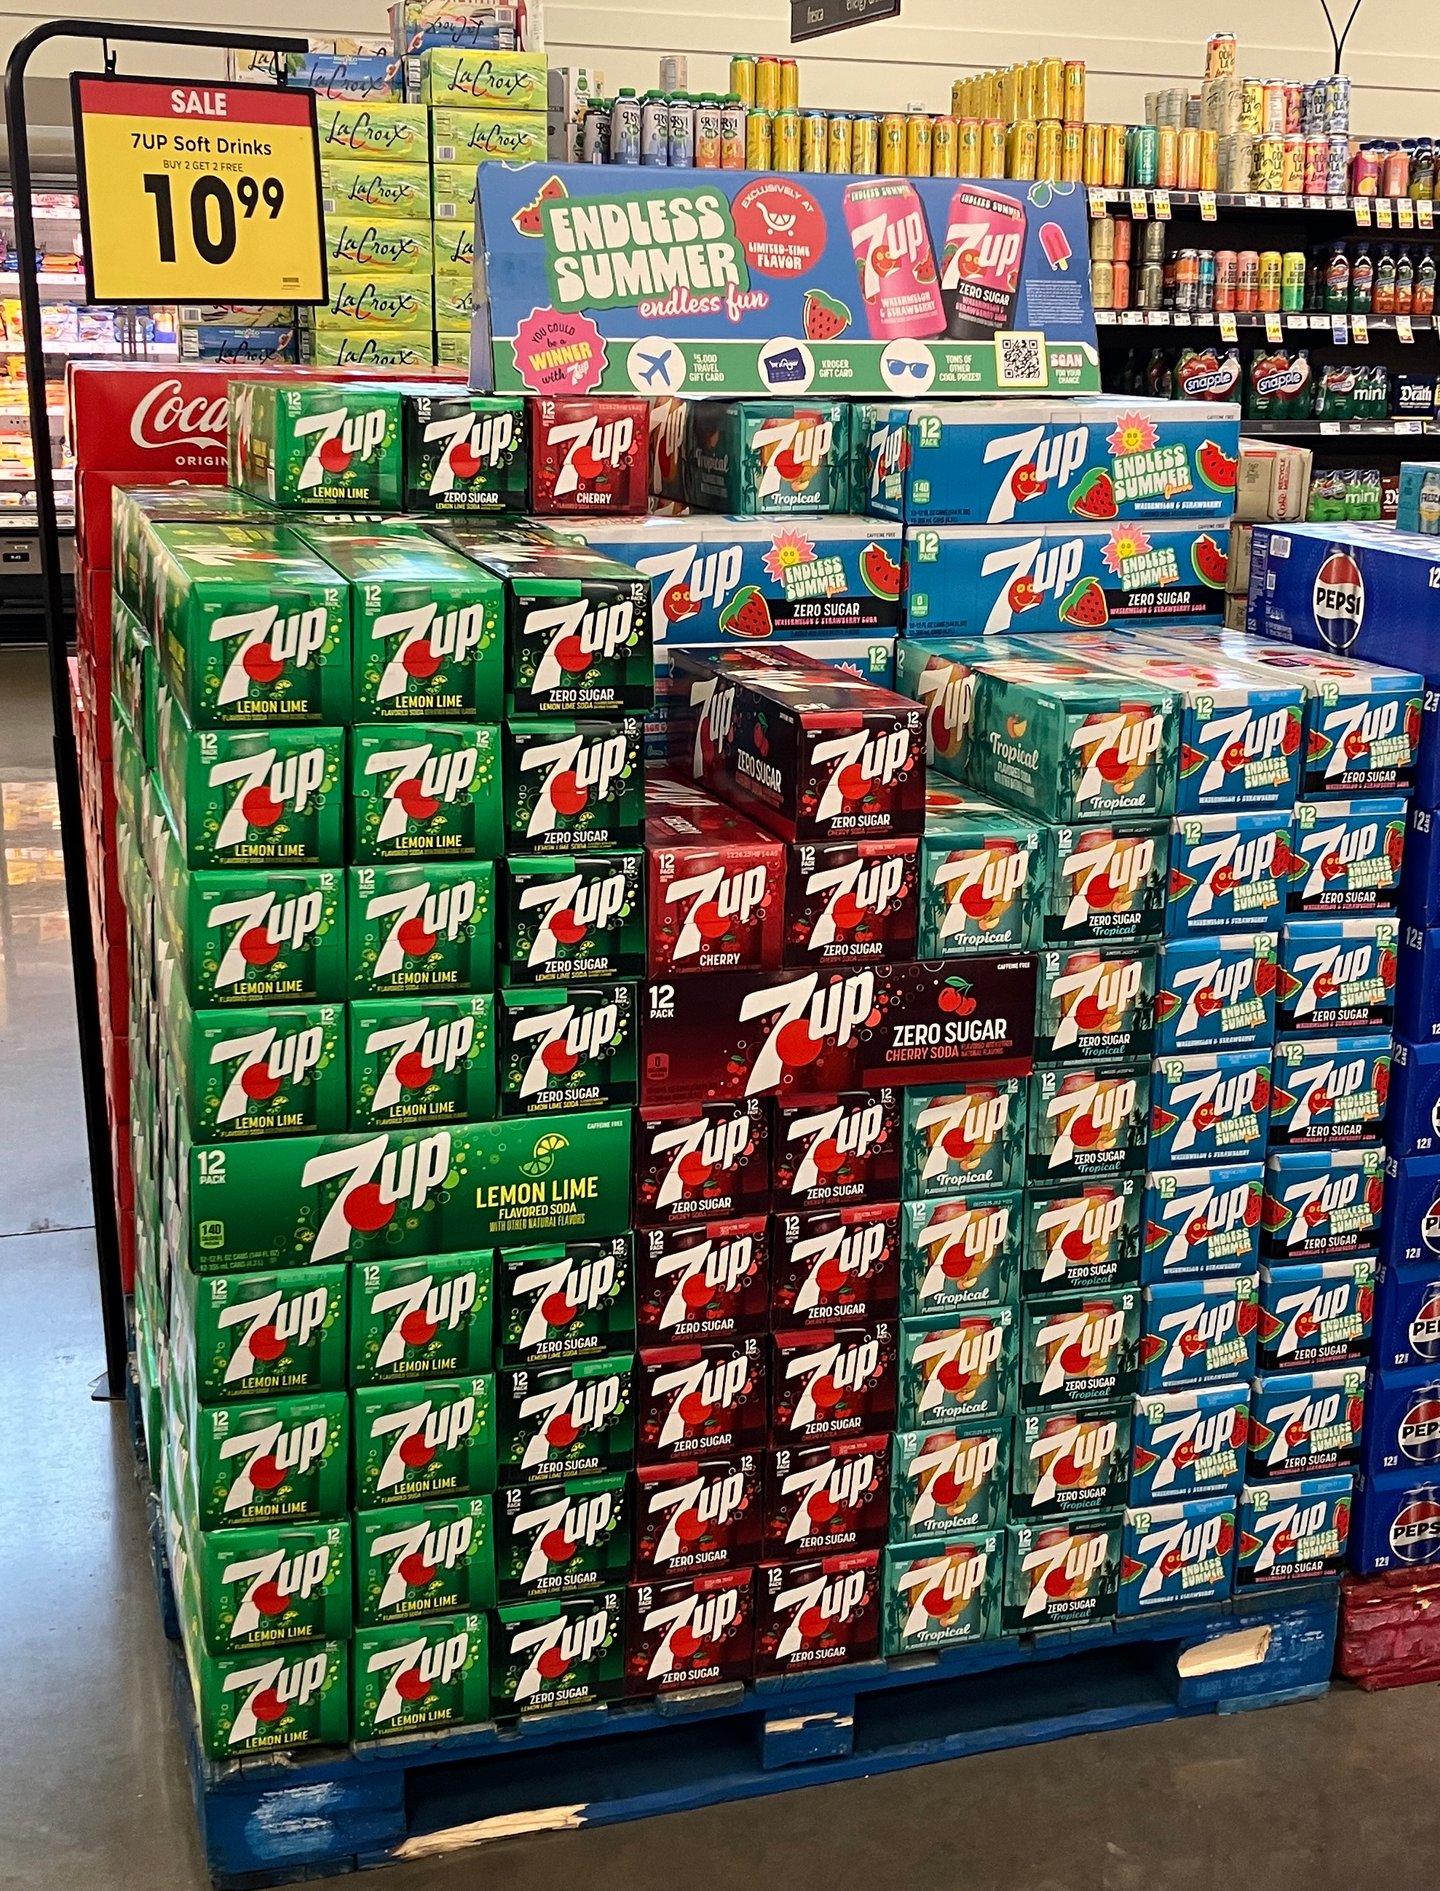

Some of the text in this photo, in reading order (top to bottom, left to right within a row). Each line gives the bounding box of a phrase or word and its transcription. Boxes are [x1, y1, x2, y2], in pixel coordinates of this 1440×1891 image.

[449, 58, 530, 97] LaCroix
[171, 89, 228, 116] SALE
[325, 111, 408, 149] LaCroix
[467, 123, 528, 153] LaCroix
[131, 133, 273, 156] 7UP Soft Drinks
[163, 160, 244, 172] BUY 2 GET 2 FREE
[348, 175, 412, 207] LaCroix
[741, 183, 815, 214] EXCLUSIVELY AT
[549, 195, 725, 253] ENDLESS
[332, 226, 413, 264] LaCroix
[749, 241, 811, 258] LIMITED-TIME
[757, 255, 802, 270] FLAVOR
[851, 211, 923, 300] 7up
[941, 222, 1020, 290] 7up
[553, 243, 739, 303] SUMMER
[331, 282, 413, 320] LaCroix
[640, 283, 769, 322] endless fun
[881, 292, 931, 306] WATERMELON
[959, 282, 1010, 305] ZERO SUGAR
[532, 323, 576, 343] YOU COULD
[547, 337, 559, 347] be
[528, 342, 593, 371] WINNER
[822, 360, 849, 370] KROGER
[945, 355, 972, 364] TONS OF
[541, 362, 589, 385] with 7up
[689, 372, 725, 383] GIFT CARD
[693, 363, 719, 373] TRAVEL
[819, 367, 854, 378] GIFT CARD
[938, 372, 981, 382] COOL PRIZES!
[949, 363, 971, 373] OTHER
[1055, 369, 1082, 377] FOR YOUR
[1058, 376, 1080, 385] CHANCE
[1188, 371, 1232, 390] snapple
[1260, 371, 1301, 390] snapple
[287, 392, 301, 405] 12
[1354, 385, 1386, 402] mini
[1400, 386, 1432, 402] Death
[417, 398, 431, 411] 12
[541, 401, 555, 414] 12
[830, 407, 841, 420] 12
[919, 417, 941, 439] 12
[294, 407, 386, 491] 7up
[920, 439, 938, 447] PACK
[423, 411, 514, 497] 7up
[547, 415, 634, 496] 7up
[752, 420, 833, 498] 7up
[1114, 445, 1185, 480] ENDLESS
[983, 425, 1089, 523] 7up
[1114, 466, 1191, 502] SUMMER
[313, 487, 369, 500] LEMON LIME
[443, 492, 499, 504] ZERO SUGAR
[576, 493, 612, 505] CHERRY
[771, 491, 821, 505] Tropical
[1345, 489, 1379, 504] mini
[917, 532, 938, 553] 12
[919, 553, 937, 562] PACK
[1122, 548, 1175, 575] ENDLESS
[785, 556, 842, 583] ENDLESS
[1122, 563, 1178, 591] SUMMER
[636, 543, 743, 642] 7up
[786, 572, 846, 601] SUMMER
[981, 538, 1083, 635] 7up
[1128, 591, 1191, 607] ZERO SUGAR
[1316, 586, 1361, 615] PEPSI
[793, 602, 860, 618] ZERO SUGAR
[209, 604, 327, 706] 7up
[523, 599, 633, 695] 7up
[549, 688, 614, 702] ZERO SUGAR
[237, 699, 308, 713] LEMON LIME
[1072, 714, 1163, 803] 7up
[1199, 707, 1287, 795] 7up
[737, 748, 782, 793] ZERO SUGAR
[811, 729, 909, 823] 7up
[1342, 771, 1396, 783] ZERO SUGAR
[1090, 794, 1147, 809] Tropical
[831, 814, 890, 829] ZERO SUGAR
[1062, 839, 1154, 930] 7up
[665, 865, 767, 961] 7up
[1089, 913, 1141, 926] ZERO SUGAR
[1093, 925, 1136, 936] Tropical
[700, 953, 740, 966] CHERRY
[649, 985, 675, 1009] 12
[650, 1009, 674, 1019] PACK
[739, 971, 875, 1097] 7up
[892, 1018, 1007, 1048] ZERO SUGAR
[885, 1045, 959, 1062] CHERRY SODA
[586, 1120, 624, 1130] CAFFEINE FREE
[197, 1150, 226, 1176] 12
[199, 1174, 226, 1185] PACK
[301, 1131, 452, 1263] 7up
[476, 1176, 599, 1209] LEMON LIME
[498, 1203, 577, 1220] FLAVORED SODA
[202, 1224, 222, 1237] 140
[1254, 1500, 1328, 1573] 7up
[918, 1625, 972, 1642] Tropical
[662, 1666, 720, 1683] ZERO SUGAR
[222, 1653, 327, 1745] 7up
[246, 1730, 309, 1749] LEMON LIME
